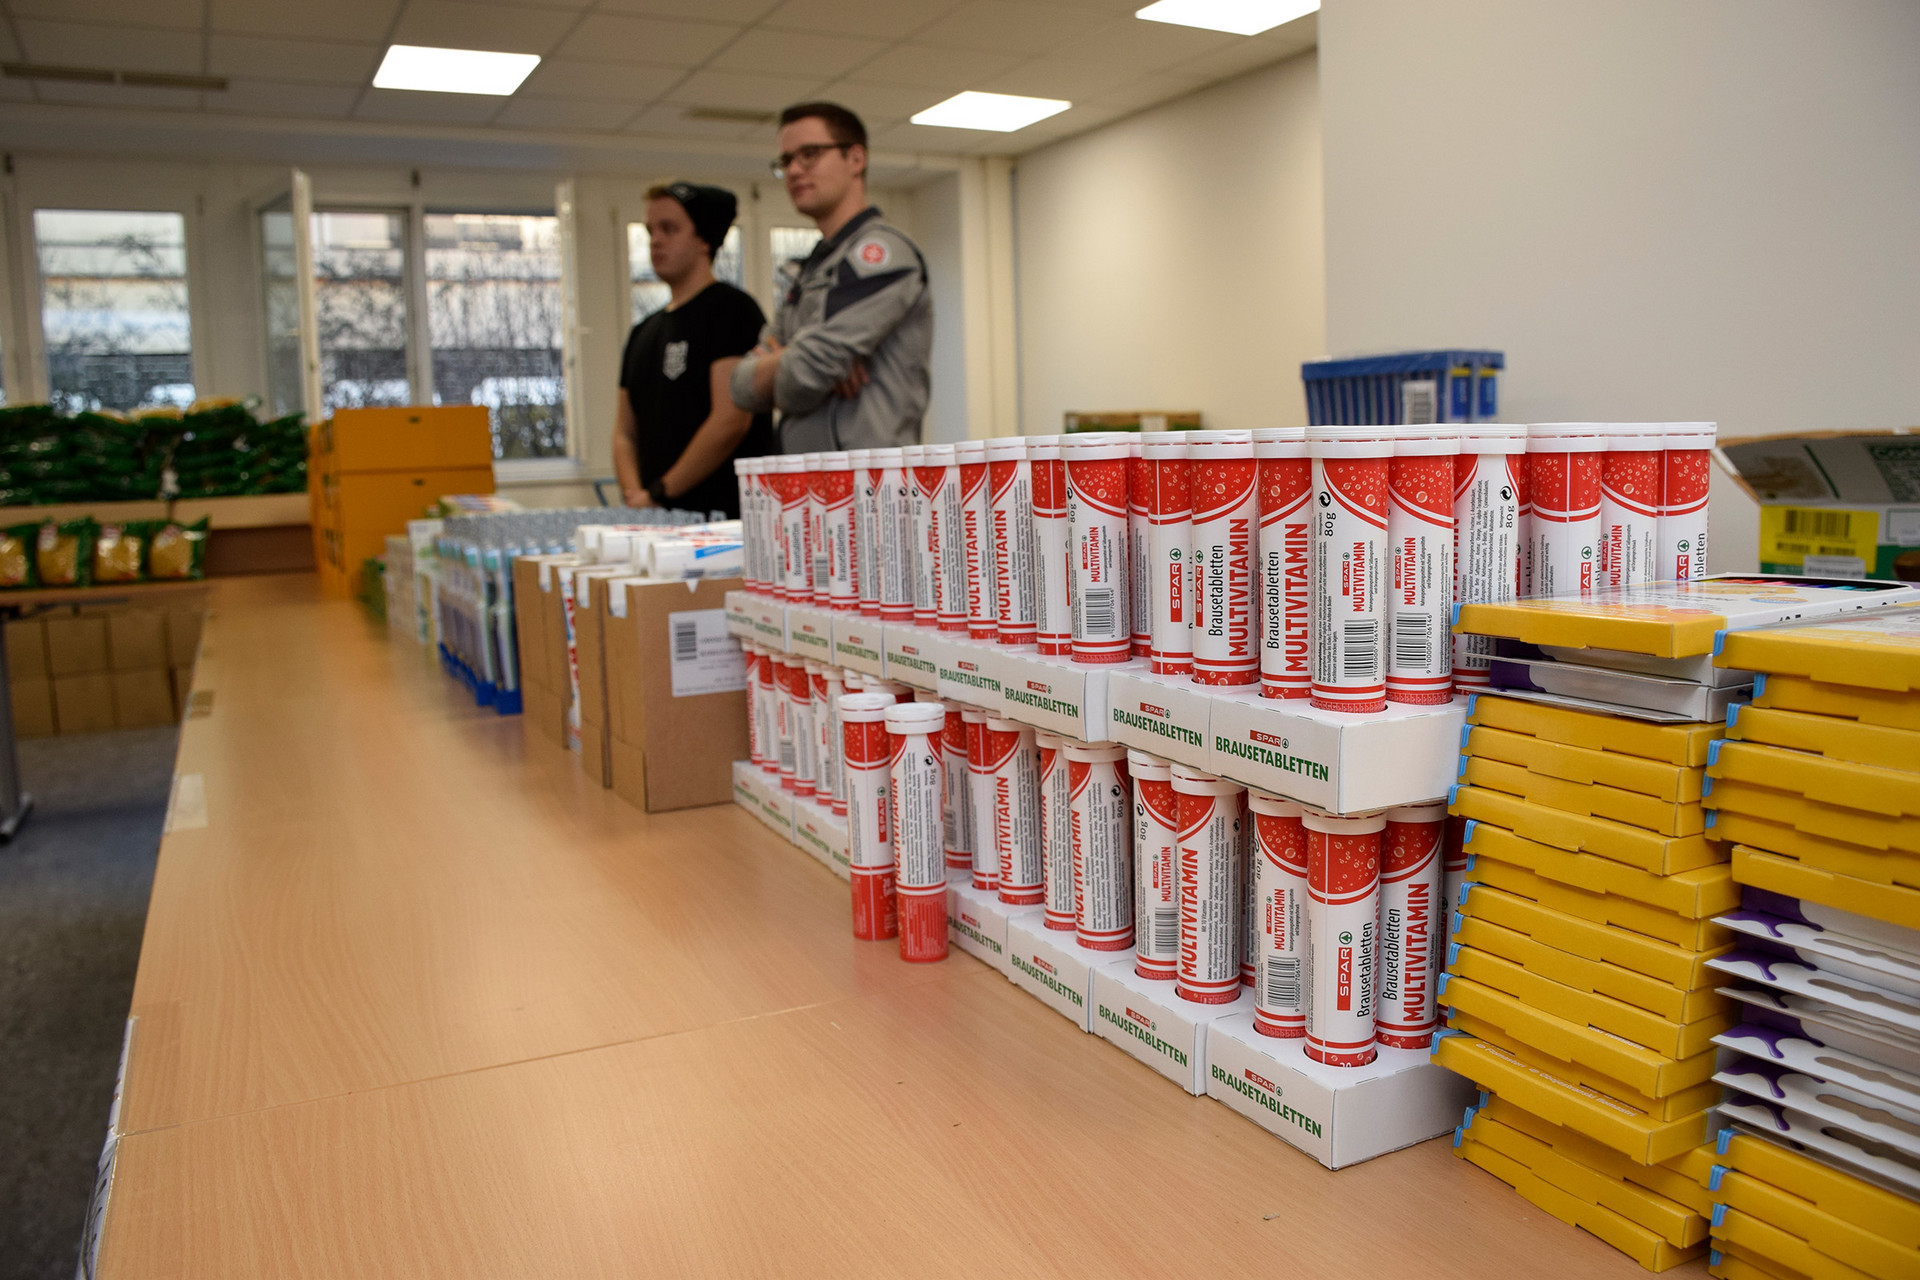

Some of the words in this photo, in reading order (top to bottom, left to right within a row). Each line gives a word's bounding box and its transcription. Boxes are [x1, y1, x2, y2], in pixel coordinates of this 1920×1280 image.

[1324, 512, 1336, 537] 80g
[1505, 505, 1515, 529] 80g
[964, 510, 981, 618] MULTIVITAMIN
[994, 509, 1011, 621] MULTIVITAMIN
[1089, 526, 1100, 583] MULTIVITAMIN
[1353, 542, 1365, 612] MULTIVITAMIN
[1404, 537, 1416, 605] MULTIVITAMIN
[1610, 524, 1622, 586] MULTIVITAMIN
[1171, 564, 1181, 609] SPAR
[1208, 545, 1224, 636] Brausetabletten
[1229, 518, 1249, 657] MULTIVITAMIN
[1266, 551, 1280, 649] Brausetabletten
[1284, 523, 1308, 672] MULTIVITAMIN
[939, 668, 1001, 692] BRAUSETABLETTEN
[1005, 687, 1079, 718] BRAUSETABLETTEN
[1030, 682, 1047, 693] SPAR
[1113, 708, 1202, 748] BRAUSETABLETTEN
[1144, 704, 1164, 716] SPAR
[1215, 736, 1329, 782] BRAUSETABLETTEN
[1256, 733, 1281, 746] SPAR
[878, 798, 887, 833] SPAR
[996, 776, 1013, 883] MULTIVITAMIN
[1139, 820, 1148, 841] 80g
[1071, 809, 1085, 927] MULTIVITAMIN
[1161, 846, 1172, 902] MULTIVITAMIN
[948, 917, 1002, 955] RAUSETABLETTEN
[1181, 847, 1198, 978] MULTIVITAMIN
[1274, 888, 1285, 950] MULTIVITAMIN
[1011, 954, 1083, 1007] BRAUSETABLETTEN
[1340, 948, 1350, 997] SPAR
[1356, 921, 1373, 1018] Brausetabletten
[1381, 908, 1401, 1001] Brausetabletten
[1403, 883, 1430, 1022] MULTIVITAMIN
[1099, 1004, 1188, 1068] BRAUSETABLETTEN
[1130, 1010, 1150, 1027] SPAR
[1211, 1063, 1322, 1139] BRAUSETABLETTEN
[1251, 1073, 1275, 1092] SPAR
